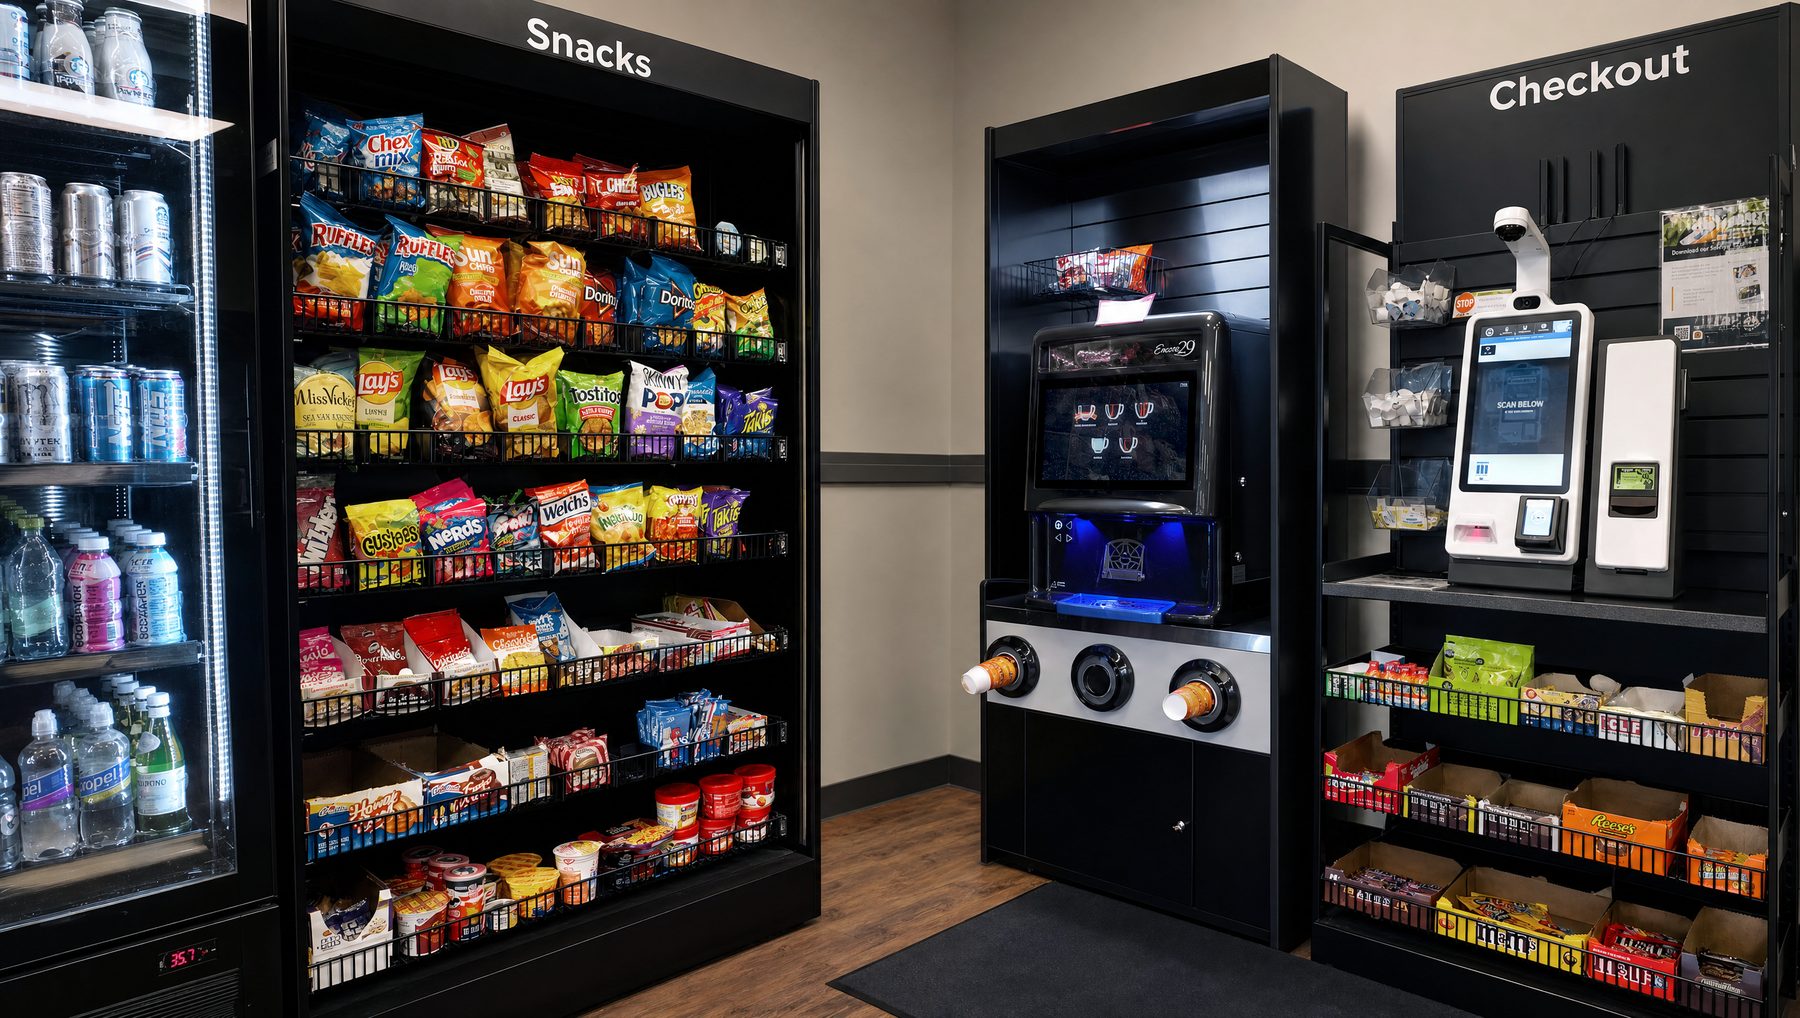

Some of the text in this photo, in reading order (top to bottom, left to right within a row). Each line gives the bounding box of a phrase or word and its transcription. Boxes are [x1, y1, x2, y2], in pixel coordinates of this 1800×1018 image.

[526, 17, 652, 78] Snacks
[1489, 44, 1690, 111] Checkout
[367, 132, 414, 154] Chex
[374, 149, 411, 172] mix
[640, 182, 686, 202] BUGLES
[310, 222, 377, 256] RUFFLES
[395, 234, 456, 268] RUFFLES
[453, 245, 493, 268] Sun
[546, 250, 582, 271] Sun
[660, 288, 696, 311] Doritos
[1456, 298, 1474, 309] STOP
[1153, 343, 1181, 356] Encore
[357, 371, 401, 396] Lay's
[438, 364, 475, 383] Lay's
[642, 367, 683, 391] SKINNY
[505, 376, 546, 403] Lay's
[568, 386, 622, 405] Tostitos
[1496, 400, 1544, 409] SCAN BELOW
[512, 413, 536, 422] CLASSIC
[542, 492, 589, 523] Welch's
[1590, 813, 1637, 836] Reese's
[171, 947, 195, 968] 35.7
